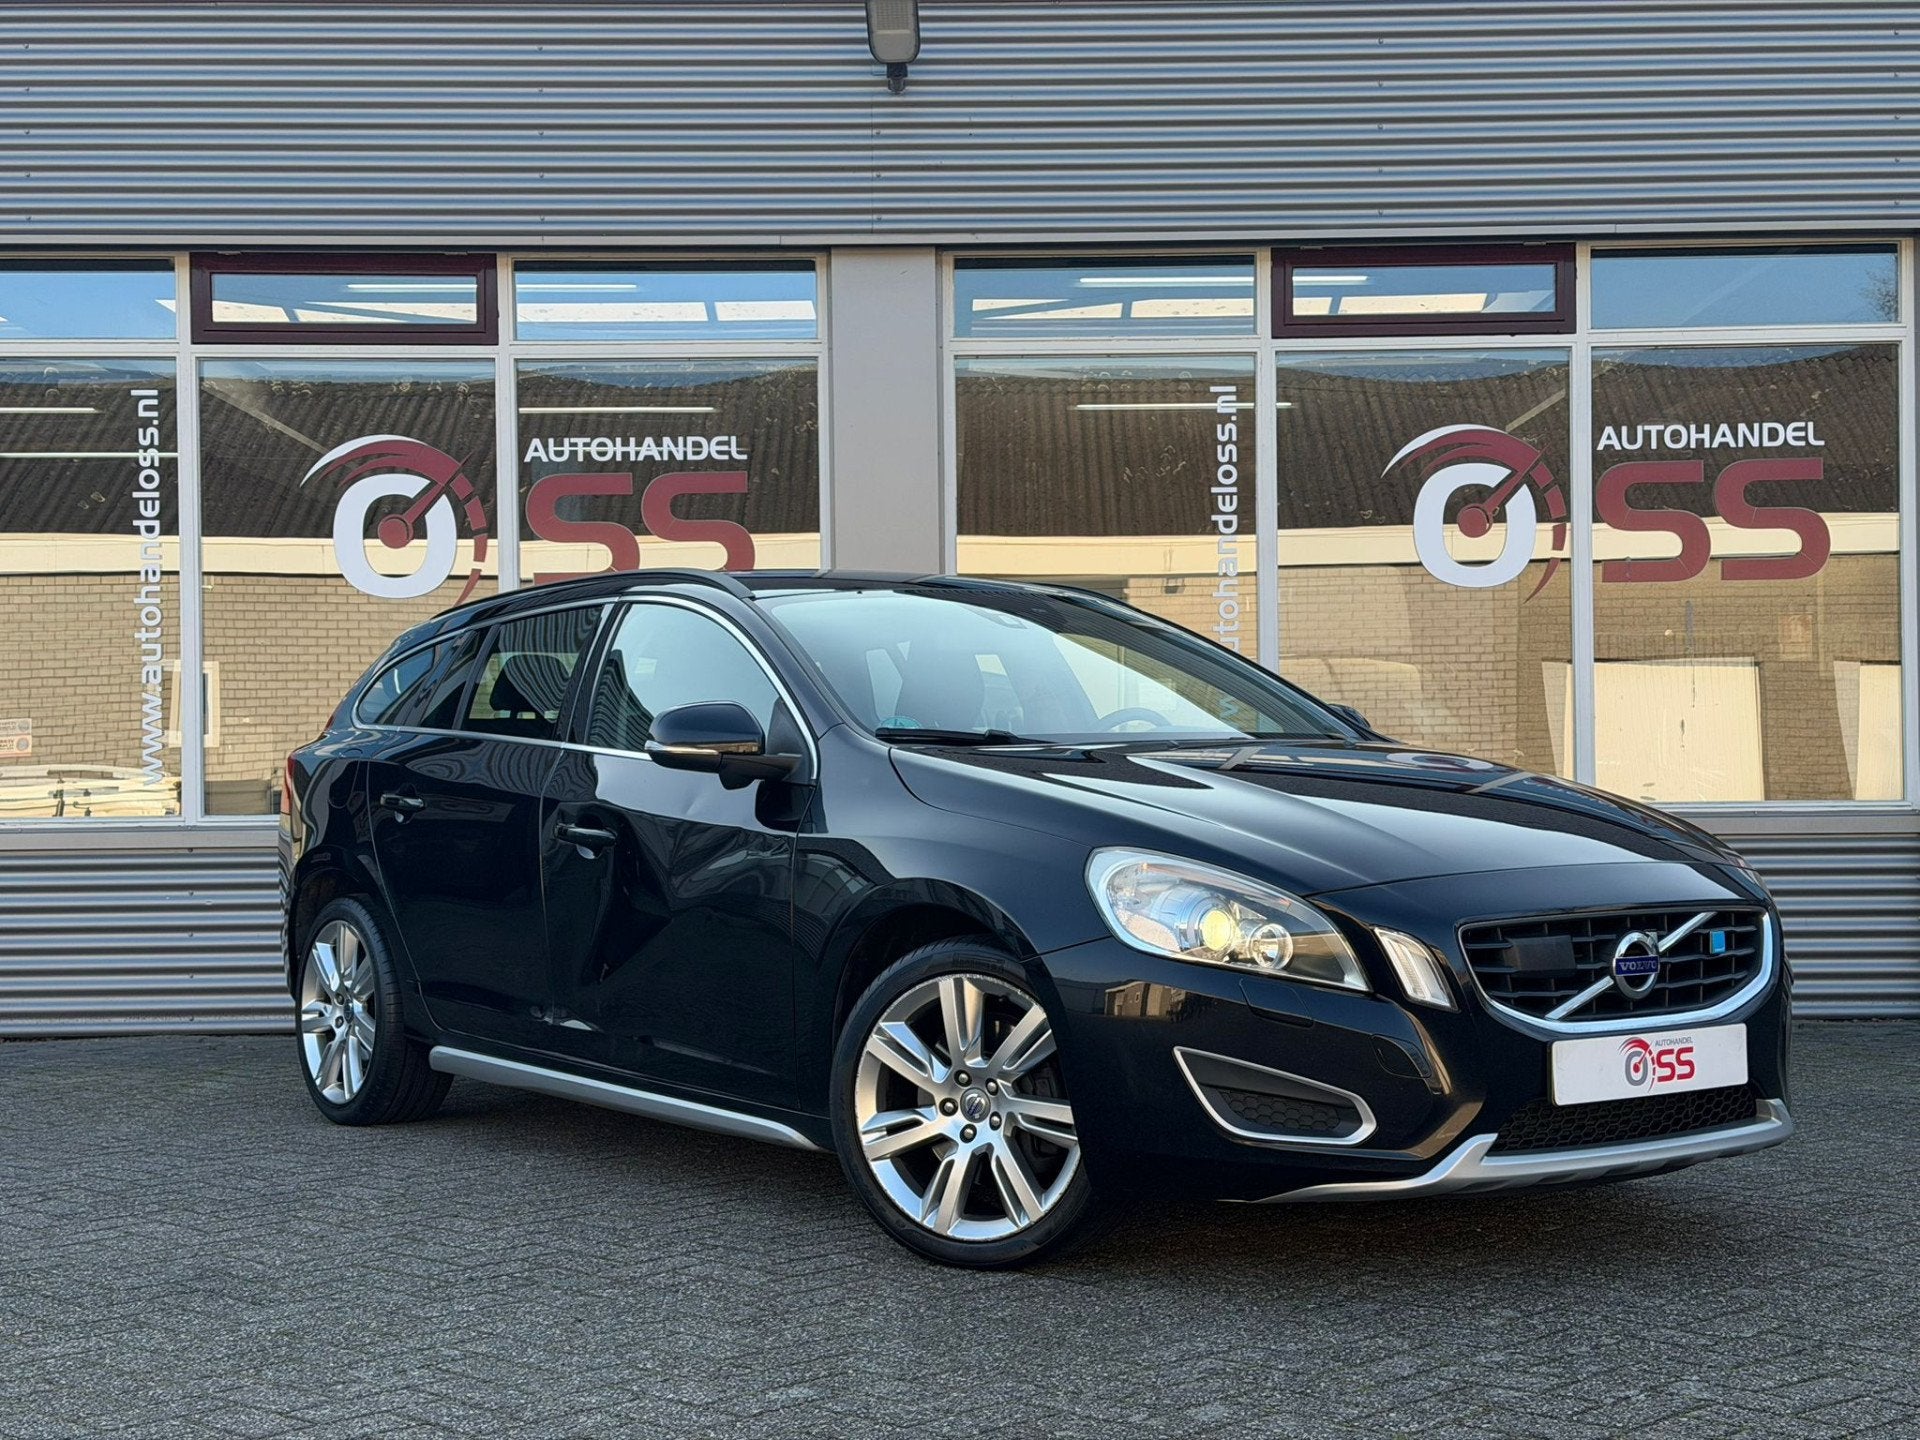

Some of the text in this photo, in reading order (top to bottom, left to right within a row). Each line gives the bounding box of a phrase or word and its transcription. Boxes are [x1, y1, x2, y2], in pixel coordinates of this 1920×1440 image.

[524, 435, 748, 462] AUTOHANDEL
[1597, 421, 1825, 450] AUTOHANDEL
[1210, 385, 1240, 653] utohandeloss.nl
[1413, 457, 1831, 588] OSS
[130, 389, 164, 786] www.autohandeloss.nl
[1619, 960, 1657, 971] VOLVO
[1655, 1036, 1693, 1046] AUTOHANDEL
[1625, 1046, 1695, 1086] OSS
